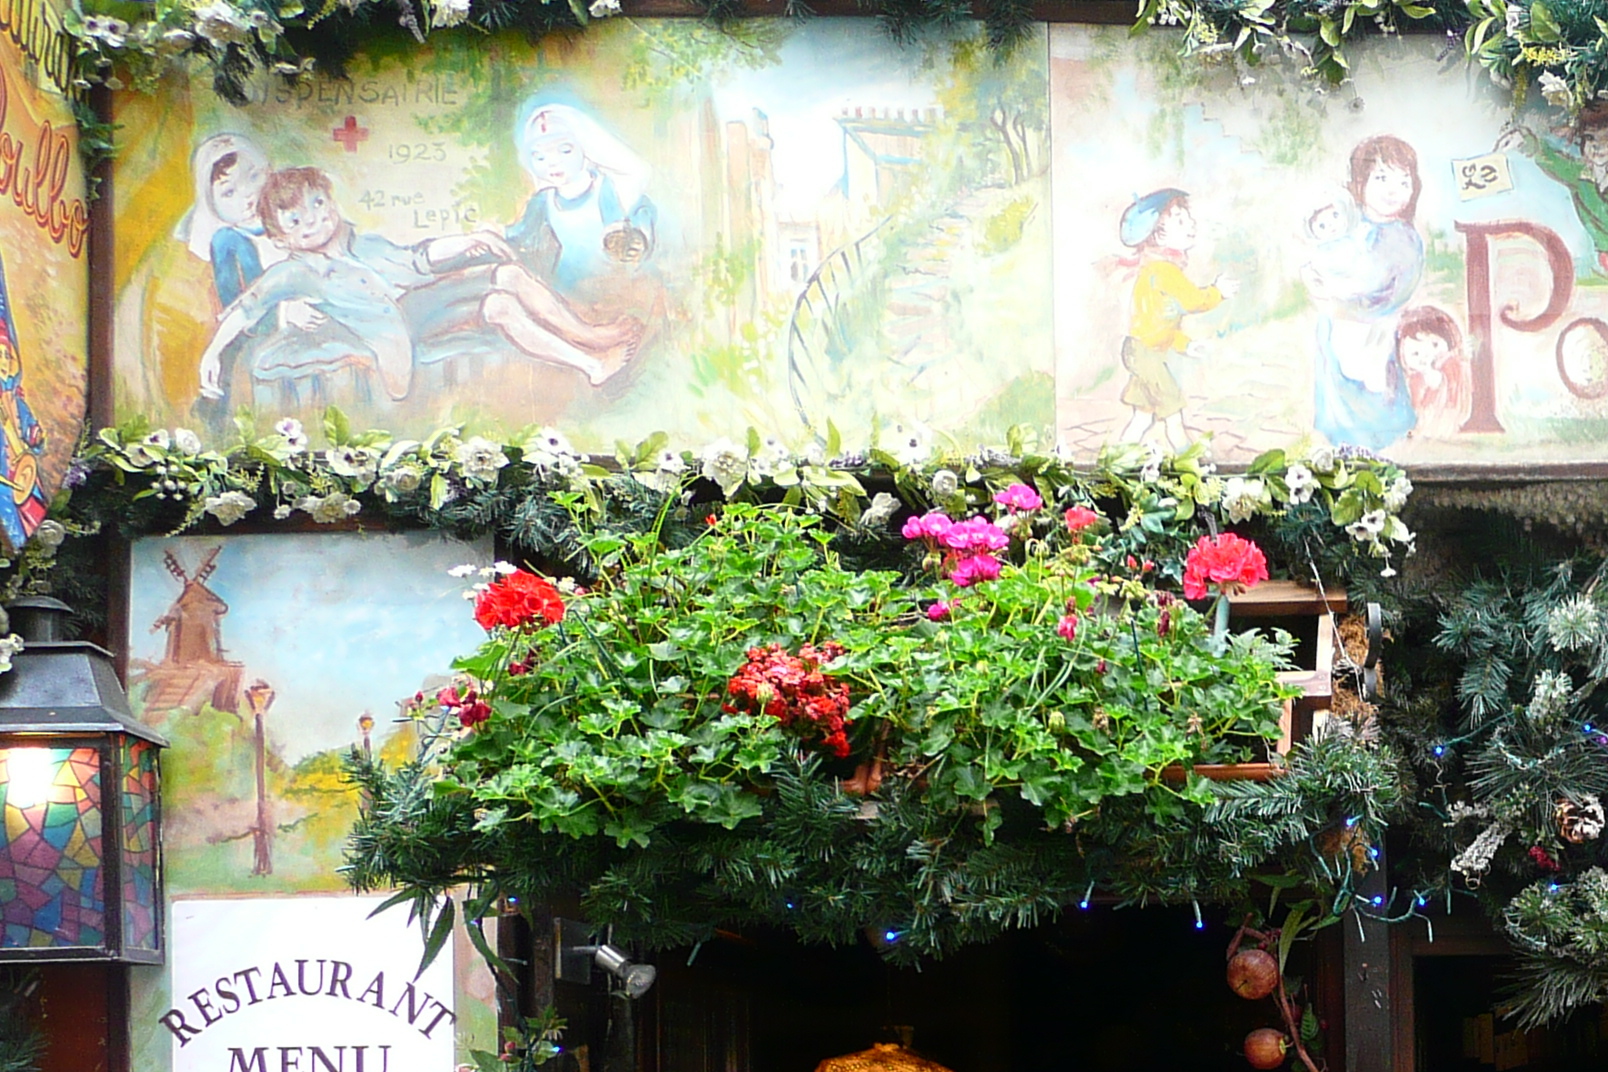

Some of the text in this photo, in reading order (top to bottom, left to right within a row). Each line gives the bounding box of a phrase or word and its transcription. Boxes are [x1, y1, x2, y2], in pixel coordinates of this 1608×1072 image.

[389, 142, 447, 164] 1923
[358, 189, 425, 211] 42 rue
[413, 207, 477, 232] Lepic
[158, 959, 457, 1048] RESTAURANT
